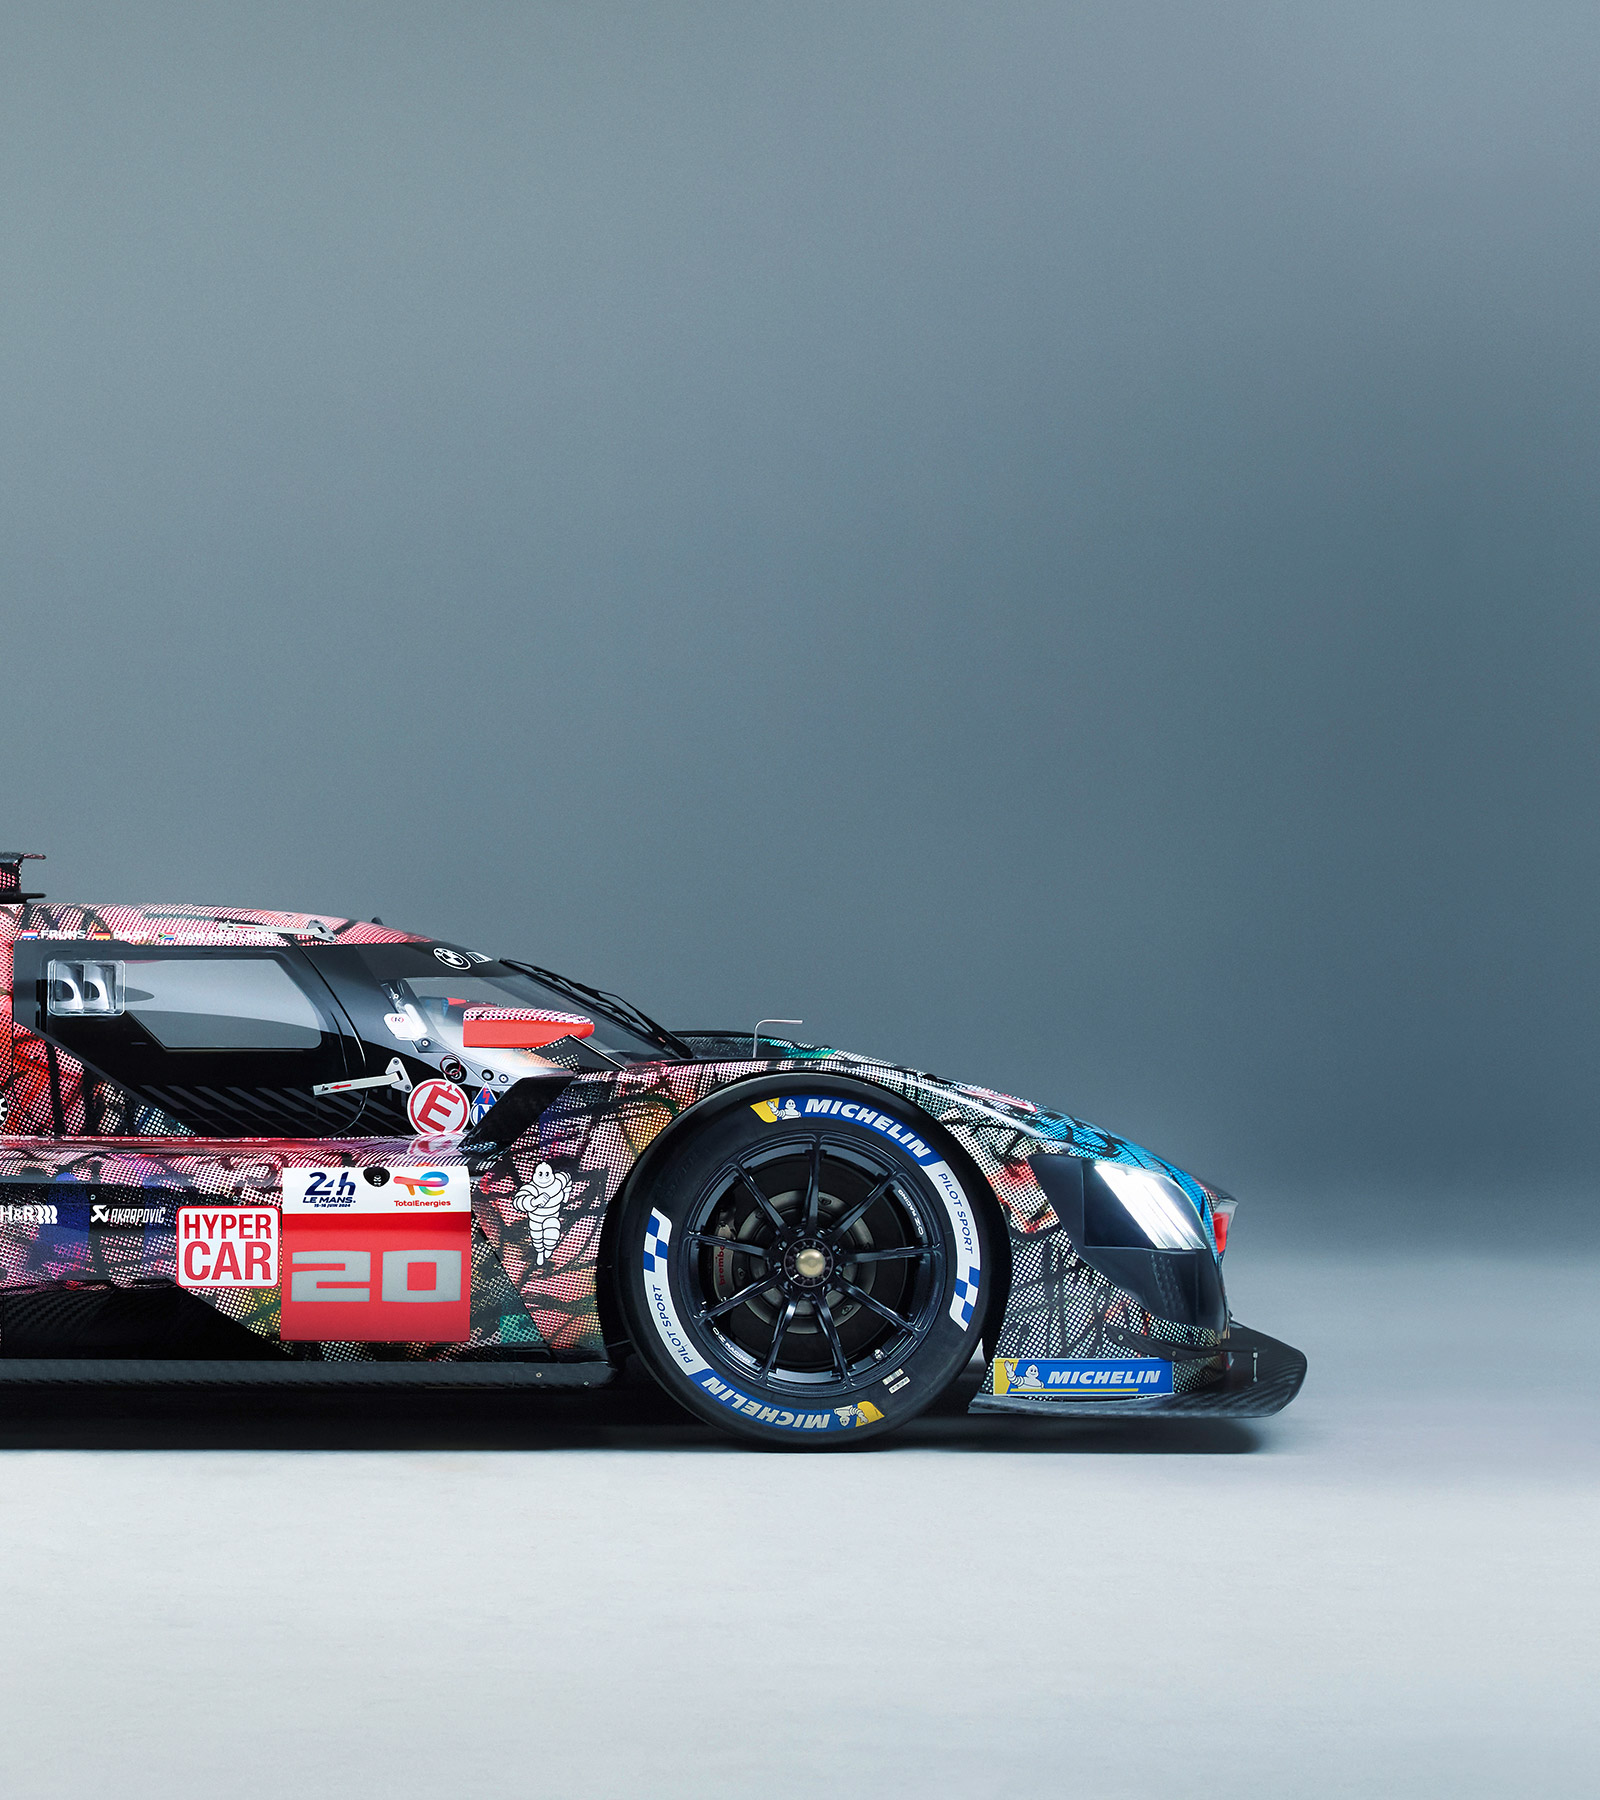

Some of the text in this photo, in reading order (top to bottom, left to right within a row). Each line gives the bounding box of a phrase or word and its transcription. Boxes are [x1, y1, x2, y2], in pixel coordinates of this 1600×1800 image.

[416, 1085, 461, 1133] E
[804, 1097, 931, 1159] MICHELIN
[302, 1196, 319, 1204] LE
[304, 1171, 357, 1196] 24h
[394, 1200, 452, 1208] TotalEnergies
[183, 1213, 272, 1240] HYPER
[937, 1172, 974, 1255] PILOT SPORT
[183, 1241, 272, 1281] CAR
[290, 1249, 462, 1303] 20
[652, 1285, 694, 1364] PILOT SPORT
[1047, 1370, 1161, 1385] MICHELIN
[701, 1375, 831, 1430] MICHELIN
